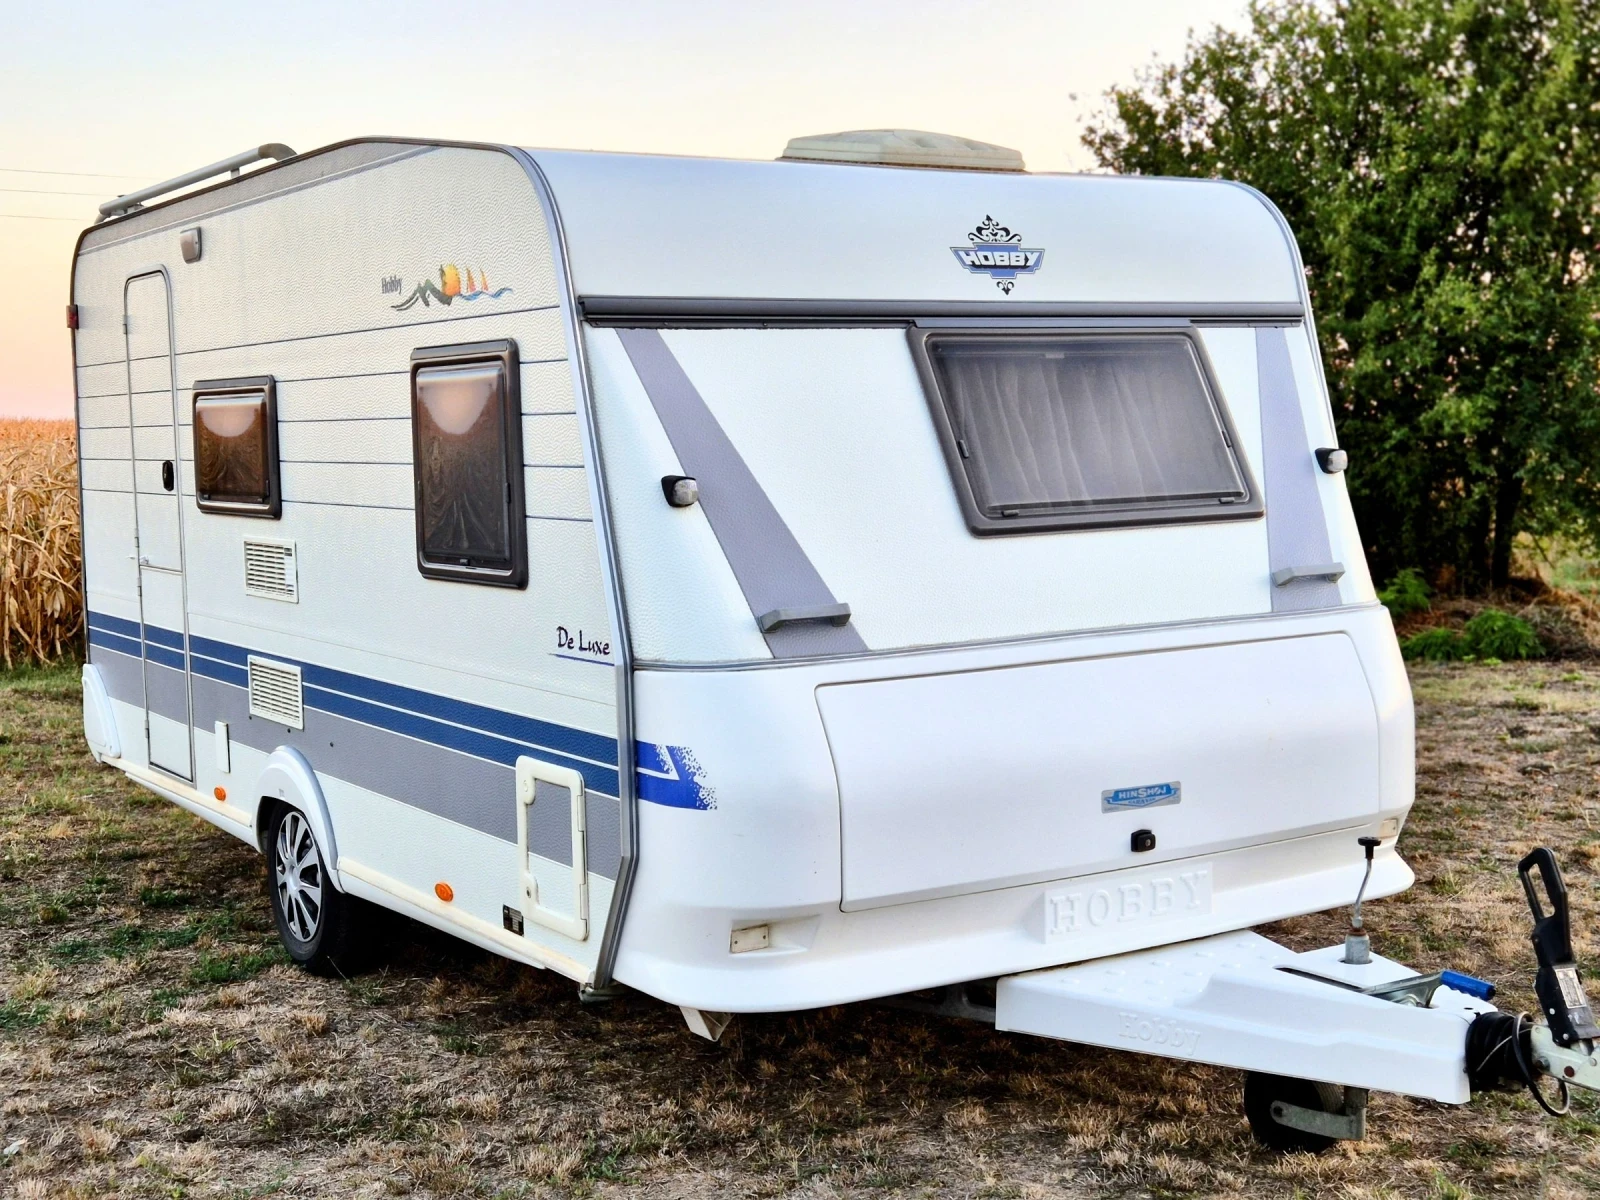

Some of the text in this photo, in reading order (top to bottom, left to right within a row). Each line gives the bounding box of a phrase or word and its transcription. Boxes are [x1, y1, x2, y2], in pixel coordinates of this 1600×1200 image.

[958, 250, 1040, 268] HOBBY
[381, 275, 402, 296] Hobby
[556, 625, 611, 656] De Luxe
[1050, 870, 1208, 936] HOBBY
[1118, 1011, 1201, 1056] Hobby
